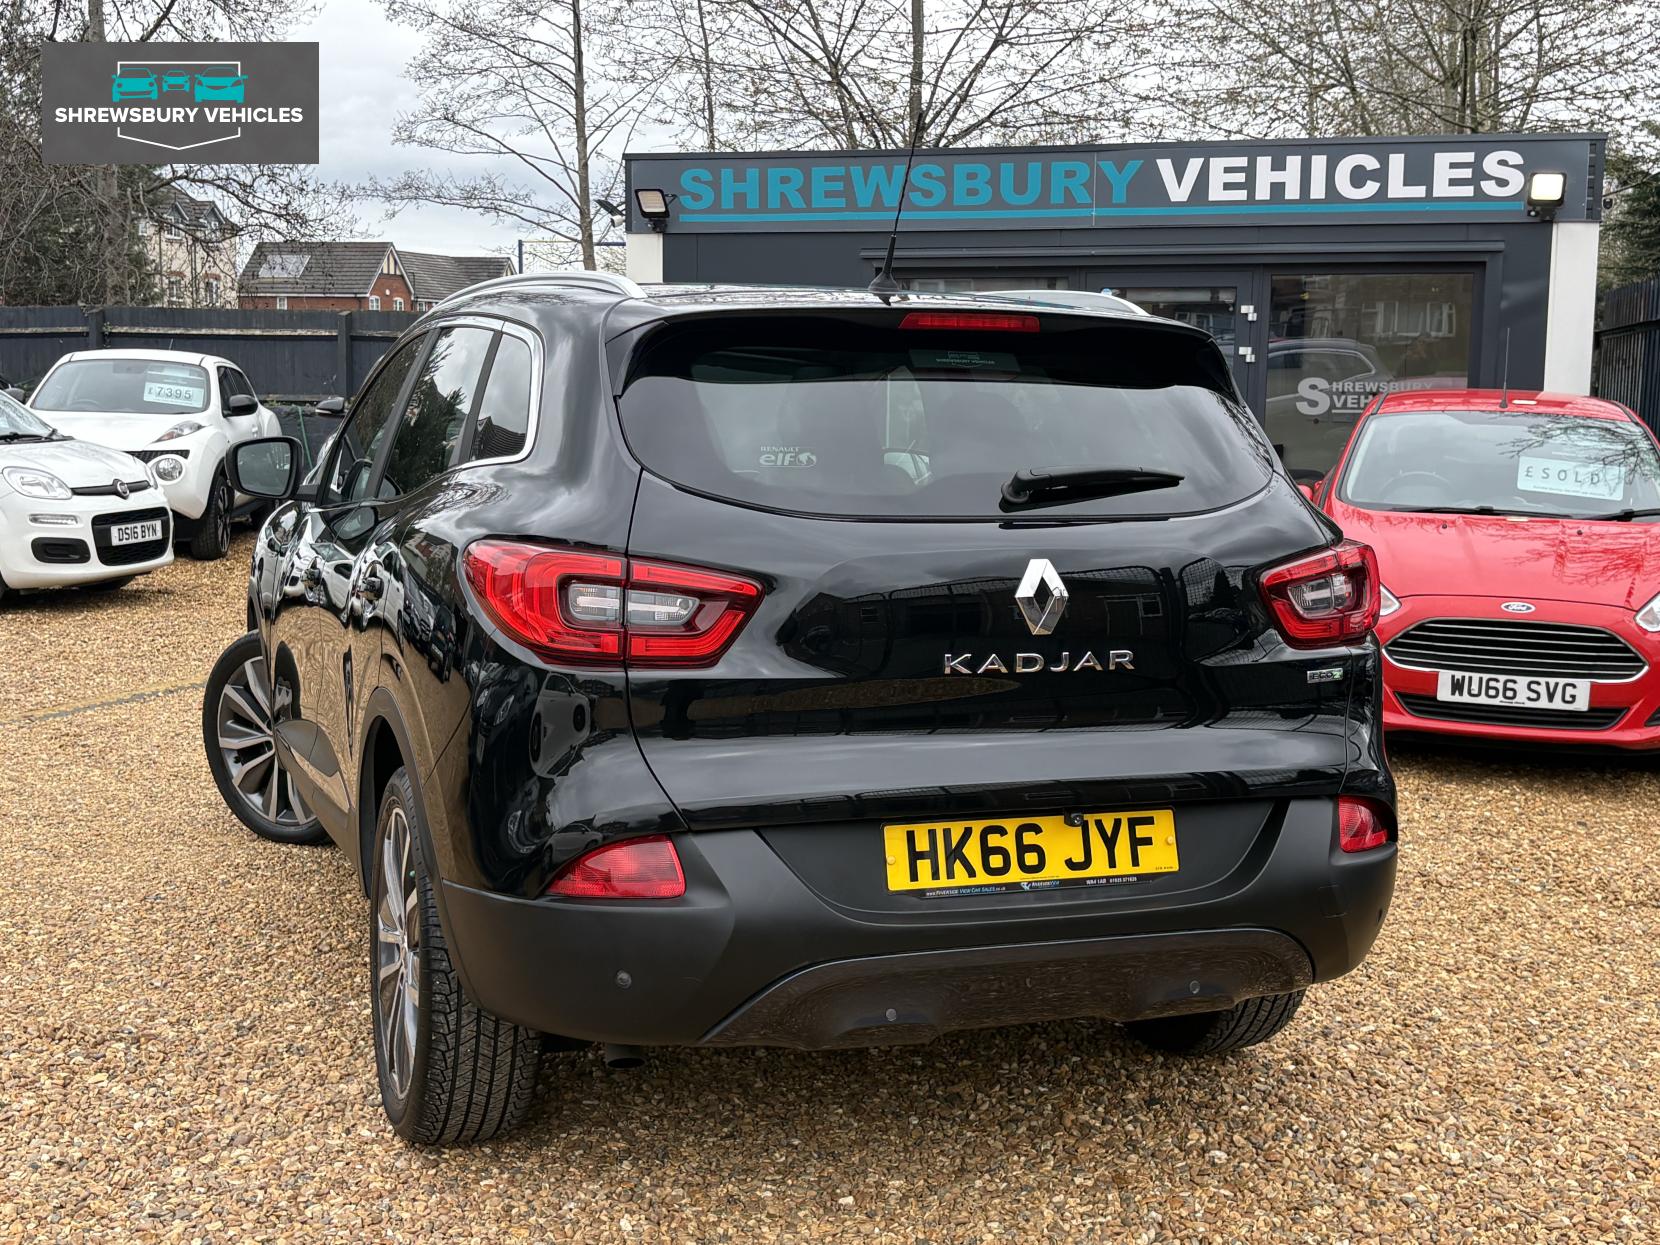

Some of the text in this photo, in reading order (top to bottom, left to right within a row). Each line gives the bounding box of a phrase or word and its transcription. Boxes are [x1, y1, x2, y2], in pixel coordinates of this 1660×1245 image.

[679, 150, 1525, 210] SHREWSBURY VEHICLES
[1296, 377, 1433, 416] SHREWSBURY
[760, 453, 795, 466] elf
[118, 523, 157, 542] DS16 BYN
[944, 649, 1135, 675] KADJAR
[1450, 674, 1577, 704] WU66 SVG
[906, 815, 1156, 883] HK66 JYF
